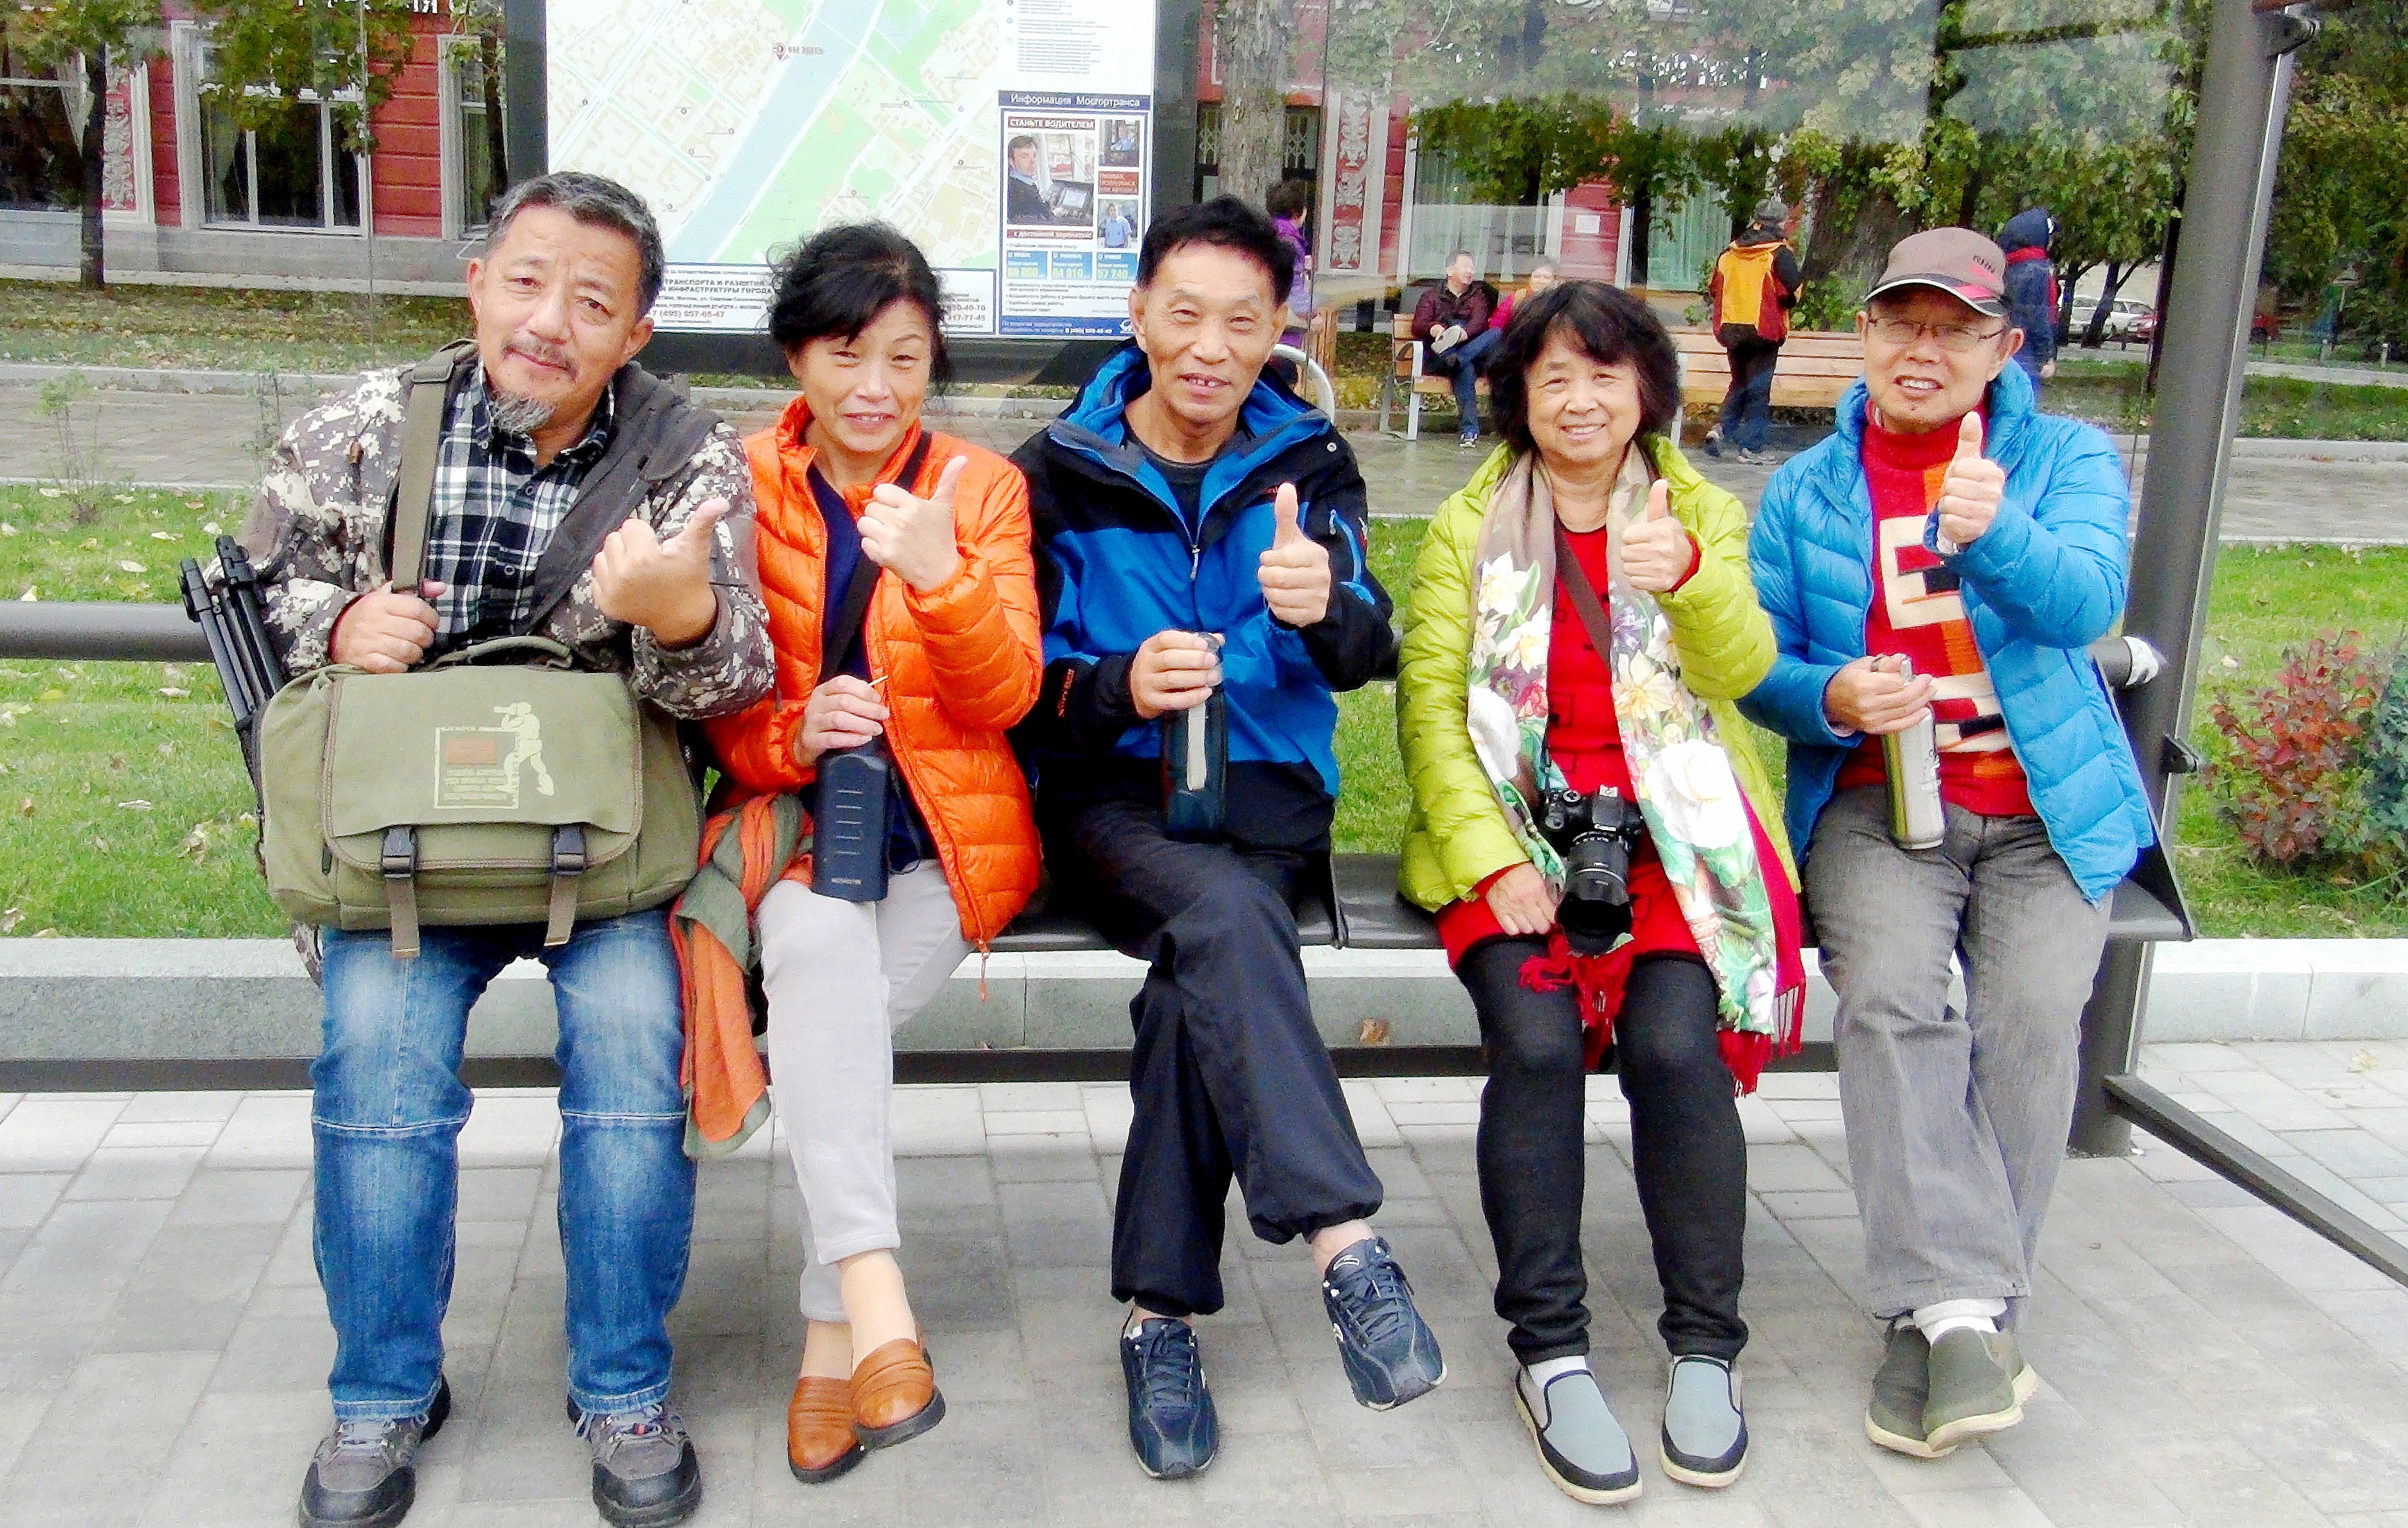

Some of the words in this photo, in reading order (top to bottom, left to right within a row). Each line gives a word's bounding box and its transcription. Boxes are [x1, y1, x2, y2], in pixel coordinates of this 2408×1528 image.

[1011, 94, 1071, 105] Информация
[1076, 95, 1141, 107] Мосгортранса
[1010, 119, 1043, 127] СТАНЬТЕ
[1045, 120, 1094, 129] ВОДИТЕЛЕМ
